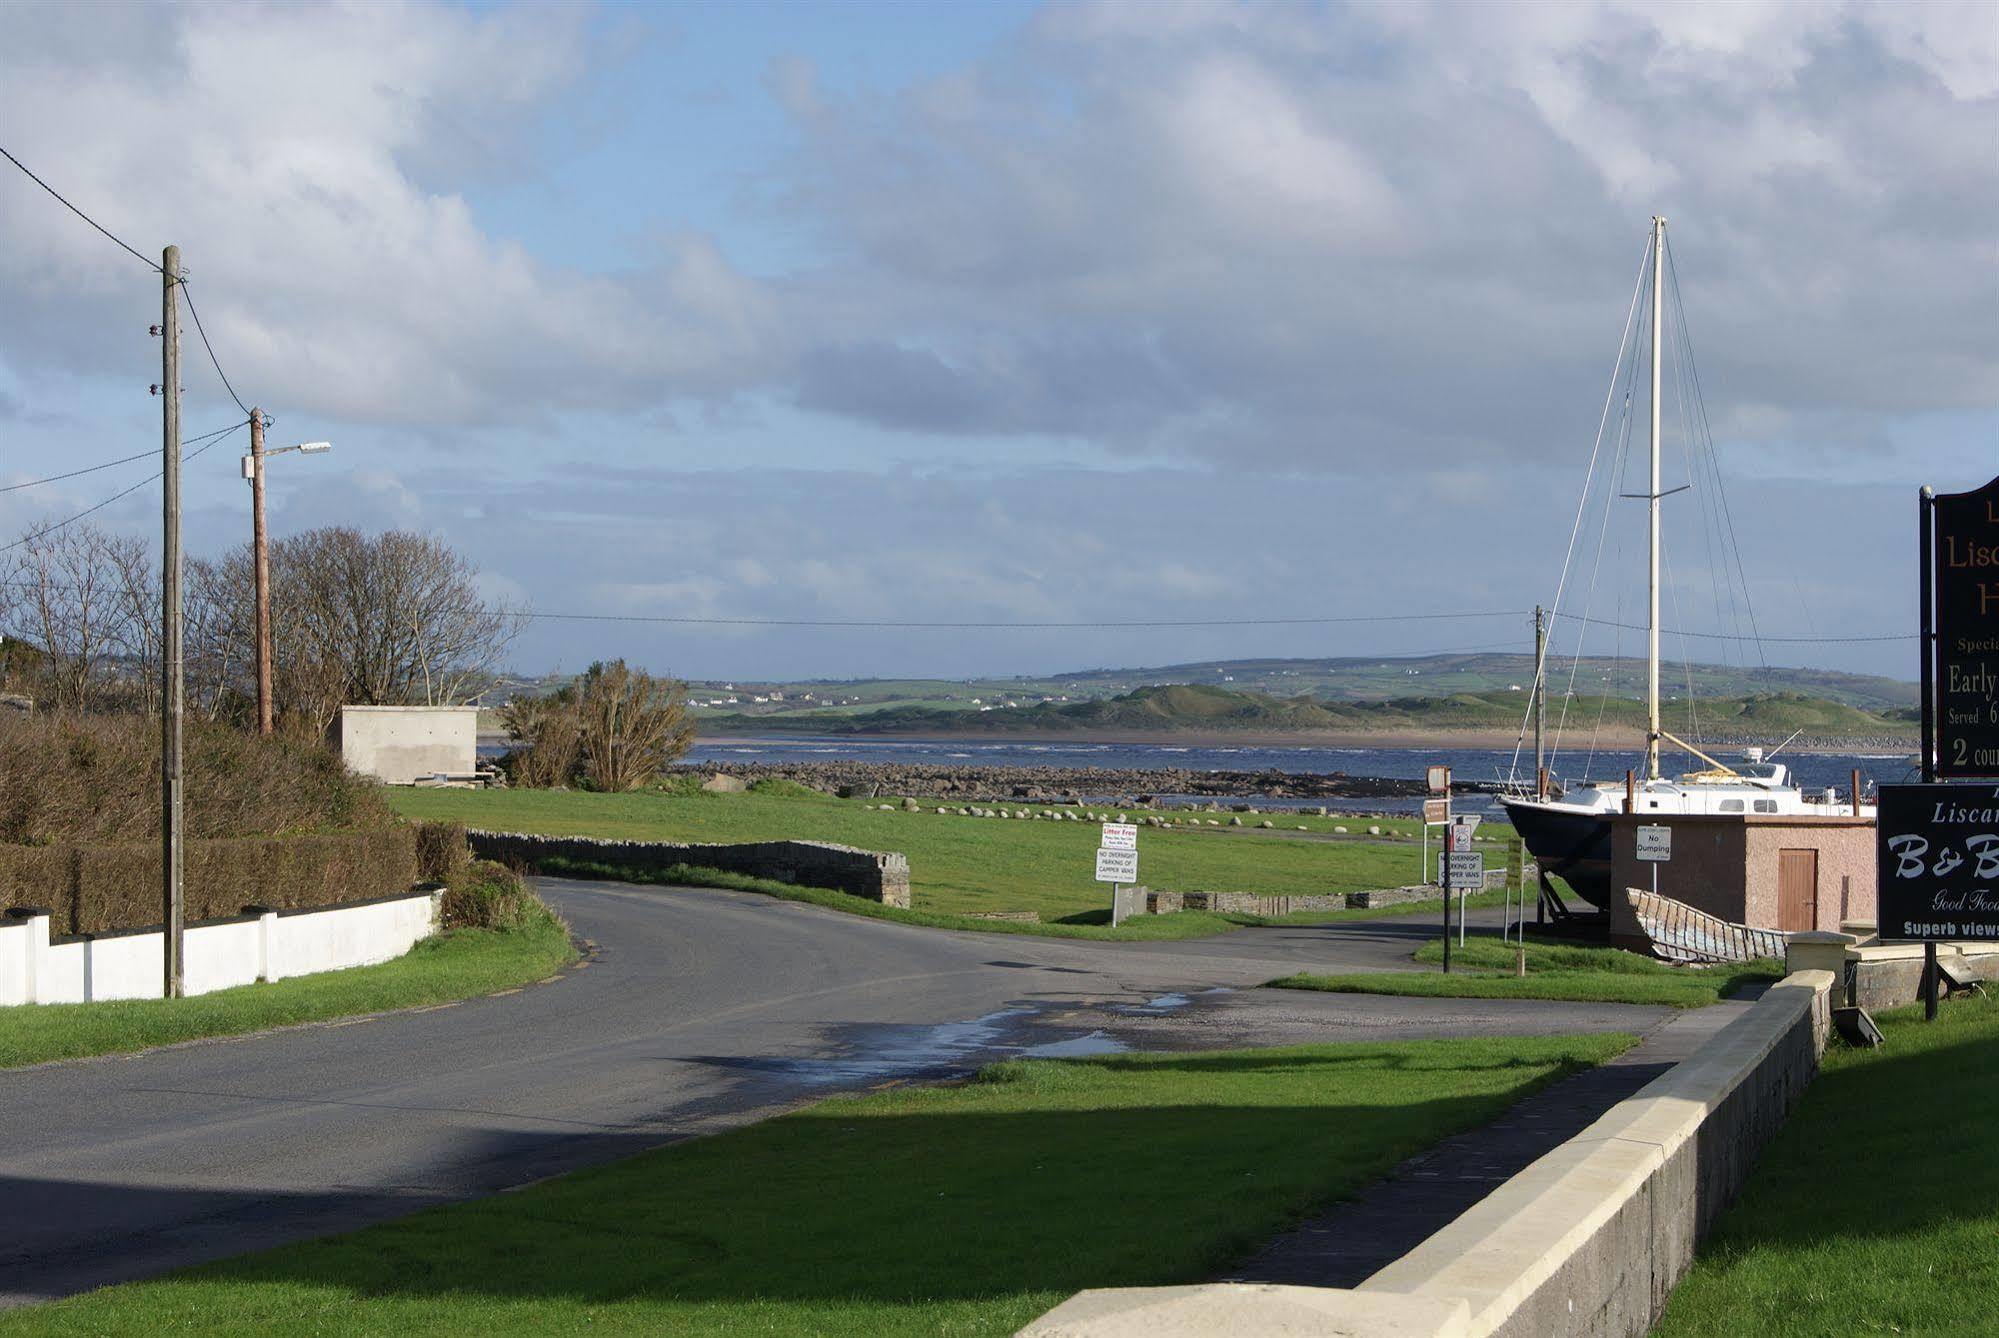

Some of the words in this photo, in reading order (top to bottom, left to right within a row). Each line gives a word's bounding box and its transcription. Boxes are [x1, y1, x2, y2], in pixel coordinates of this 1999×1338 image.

[1949, 662, 1997, 701] Early
[1949, 707, 1979, 724] Served
[1953, 738, 1967, 766] 2
[1108, 851, 1136, 859] OVERNIGHT
[1638, 845, 1670, 854] Dumping
[1931, 888, 1966, 912] Good
[1904, 920, 1956, 936] Superb
